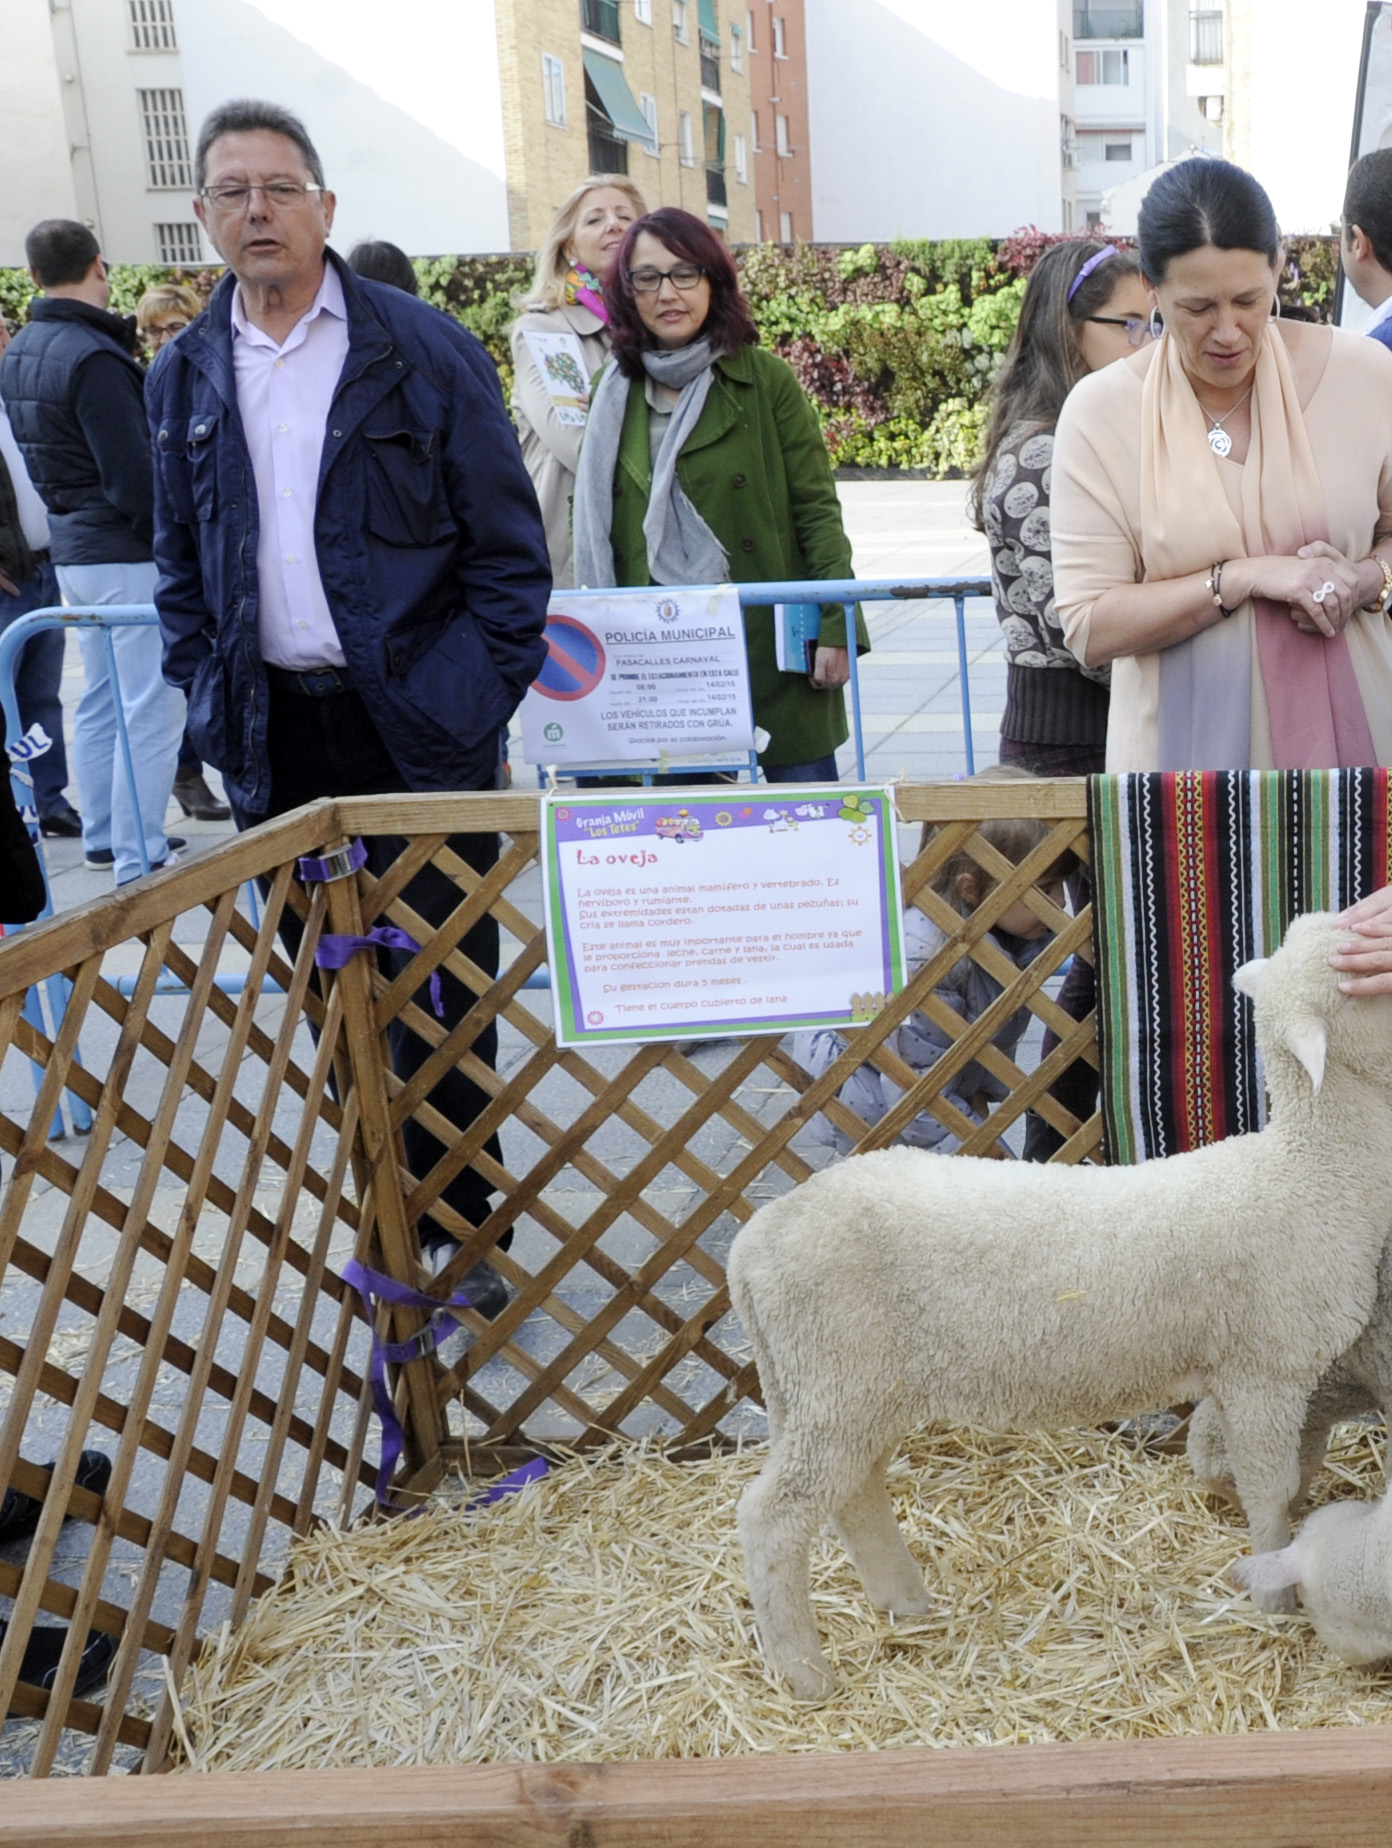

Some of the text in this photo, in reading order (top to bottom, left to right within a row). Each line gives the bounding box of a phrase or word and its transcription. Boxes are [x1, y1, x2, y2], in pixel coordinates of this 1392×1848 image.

[605, 626, 735, 642] POLICÍA MUNICIPAL
[616, 655, 720, 666] PASACALLES CARNAVAL
[601, 711, 618, 720] LOS
[669, 708, 688, 718] QUE
[689, 706, 737, 717] INCUMPLAN
[607, 720, 636, 732] SERÁN
[638, 720, 685, 730] RETIRADOS
[687, 720, 705, 728] CON
[576, 849, 658, 868] La oveja
[577, 888, 591, 898] La
[594, 886, 622, 897] oveja
[625, 887, 636, 896] es
[639, 886, 659, 896] una
[662, 884, 696, 894] animal
[753, 882, 758, 890] y
[827, 877, 840, 888] Es
[579, 910, 598, 921] Sus
[601, 908, 672, 919] extremidades
[707, 903, 751, 914] dotadas
[753, 902, 766, 912] de
[770, 902, 794, 910] unas
[847, 898, 859, 908] su
[633, 897, 639, 907] y
[603, 920, 615, 929] se
[618, 918, 645, 928] llama
[582, 928, 862, 952] Este animal es muy importante para el hombre ya que
[584, 954, 592, 962] le
[595, 950, 660, 962] proporciona
[701, 946, 732, 956] carne
[734, 946, 740, 955] y
[771, 943, 780, 952] la
[783, 942, 806, 952] cual
[809, 942, 820, 950] es
[823, 940, 854, 950] usada
[584, 964, 608, 973] para
[610, 959, 681, 972] confeccionar
[685, 956, 726, 968] prendas
[730, 955, 744, 964] de
[602, 984, 617, 994] Su
[673, 980, 699, 988] dura
[702, 978, 708, 988] 5
[710, 976, 742, 986] meses
[614, 994, 788, 1014] Tiene el cuerpo cubierto de lana
